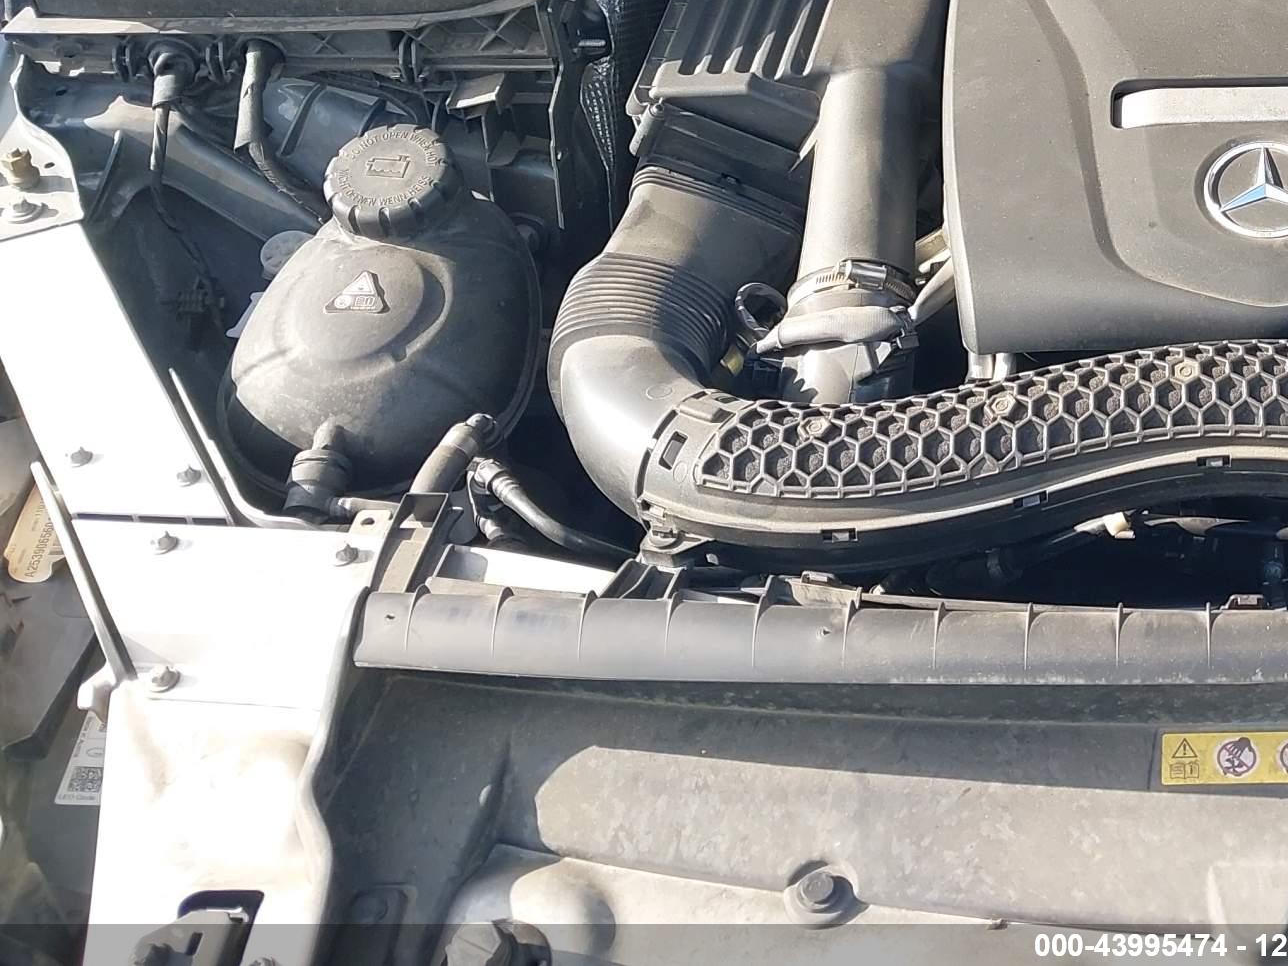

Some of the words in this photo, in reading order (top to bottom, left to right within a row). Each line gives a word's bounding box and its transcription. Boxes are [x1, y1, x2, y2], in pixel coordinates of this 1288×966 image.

[360, 135, 379, 151] NOT
[382, 131, 409, 141] OPEN
[408, 175, 433, 197] HEISS
